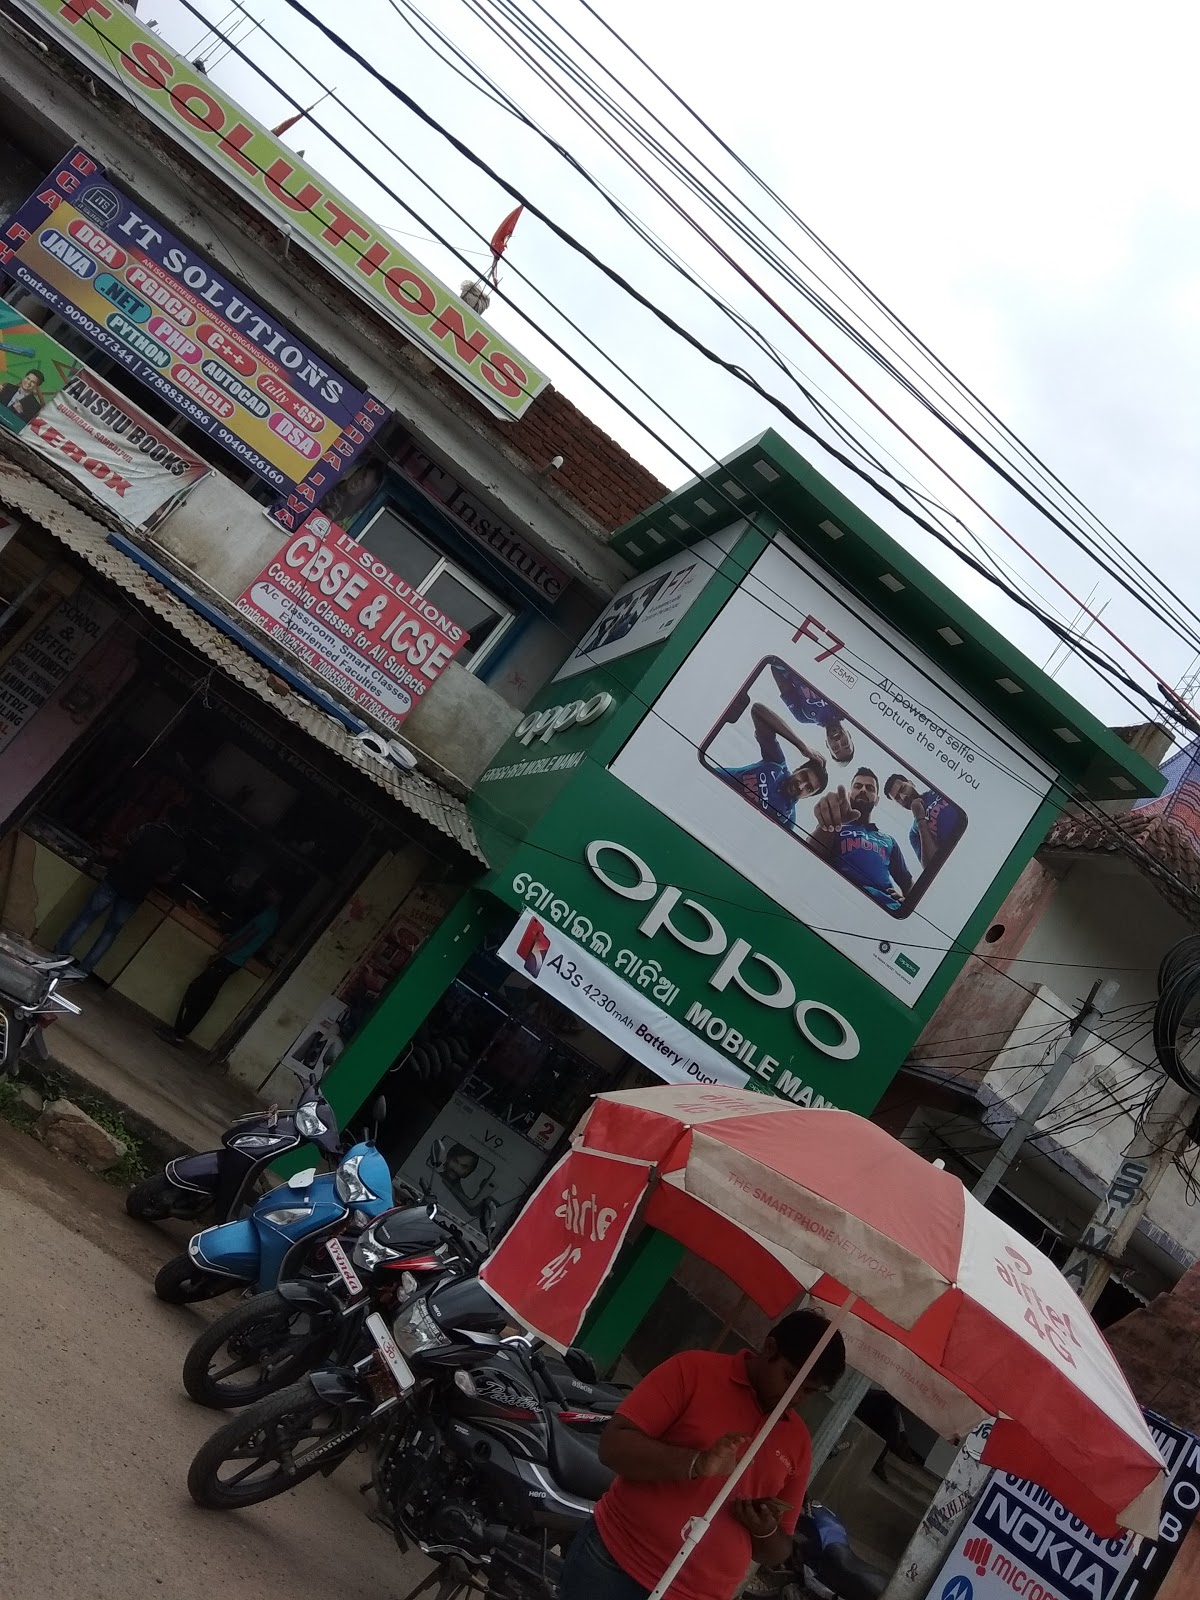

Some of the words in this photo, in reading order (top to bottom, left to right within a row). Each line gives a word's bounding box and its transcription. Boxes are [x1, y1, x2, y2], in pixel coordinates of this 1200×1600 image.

[116, 35, 535, 403] SOLUTIONS
[41, 231, 92, 276] JAVA
[100, 277, 143, 318] .NET
[154, 320, 196, 360] PHP
[202, 360, 268, 417] AUTOCAD
[273, 416, 316, 456] DSA
[75, 224, 118, 263] DCA
[128, 267, 194, 325] PGDCA
[205, 329, 248, 367] C++
[258, 375, 291, 407] Tally
[289, 399, 323, 430] +GST
[116, 209, 165, 254] IT
[159, 244, 347, 407] SOLUTIONS
[141, 257, 153, 269] AN
[151, 265, 165, 279] ISO
[163, 275, 197, 305] CERTIFIED
[195, 301, 232, 335] COMPUTER
[230, 331, 279, 373] ORGANISATION
[15, 266, 59, 304] Contact
[62, 304, 134, 364] 9090267344
[140, 365, 211, 425] 7788833886
[216, 427, 285, 485] 9040426160
[109, 314, 168, 366] PYTHON
[175, 366, 232, 416] ORACLE
[93, 431, 133, 464] SAMBALPUR
[125, 423, 191, 480] BOOKS
[441, 481, 565, 597] Institute
[57, 601, 102, 639] SCHOOL
[235, 597, 269, 627] Contact
[266, 560, 317, 611] Coaching
[314, 600, 356, 639] Classes
[352, 630, 373, 652] for
[367, 642, 386, 663] All
[381, 654, 428, 696] Subjects
[281, 528, 369, 612] CBSE
[356, 589, 392, 632] &
[379, 608, 454, 682] ICSE
[336, 533, 358, 555] IT
[357, 550, 464, 641] SOLUTIONS
[33, 627, 76, 666] OFFICE
[57, 623, 77, 642] &
[258, 580, 280, 600] A/c
[279, 597, 340, 648] Classroom,
[338, 643, 371, 673] Smart
[369, 668, 411, 705] Classes
[278, 611, 340, 663] Experienced
[337, 658, 383, 697] Faculties
[789, 613, 846, 669] F7
[831, 663, 855, 686] 25MP
[514, 691, 613, 746] oppo
[866, 690, 917, 736] Capture
[913, 728, 938, 754] the
[934, 748, 961, 772] real
[955, 768, 979, 790] you
[877, 676, 947, 739] AI-powered
[943, 732, 979, 765] selfie
[841, 835, 886, 861] INDIA
[585, 839, 862, 1062] oppo
[545, 949, 585, 989] A3s
[634, 1022, 683, 1068] Battery
[683, 1000, 780, 1081] MOBILE
[773, 1068, 837, 1109] MAN
[480, 1128, 505, 1150] V9
[536, 1120, 556, 1141] 2
[725, 1170, 752, 1192] THE
[328, 1240, 358, 1291] Vrinda
[995, 1256, 1081, 1347] airtel
[1023, 1306, 1077, 1368] 4G
[528, 1489, 546, 1499] Hero
[983, 1491, 1102, 1599] NOKIA
